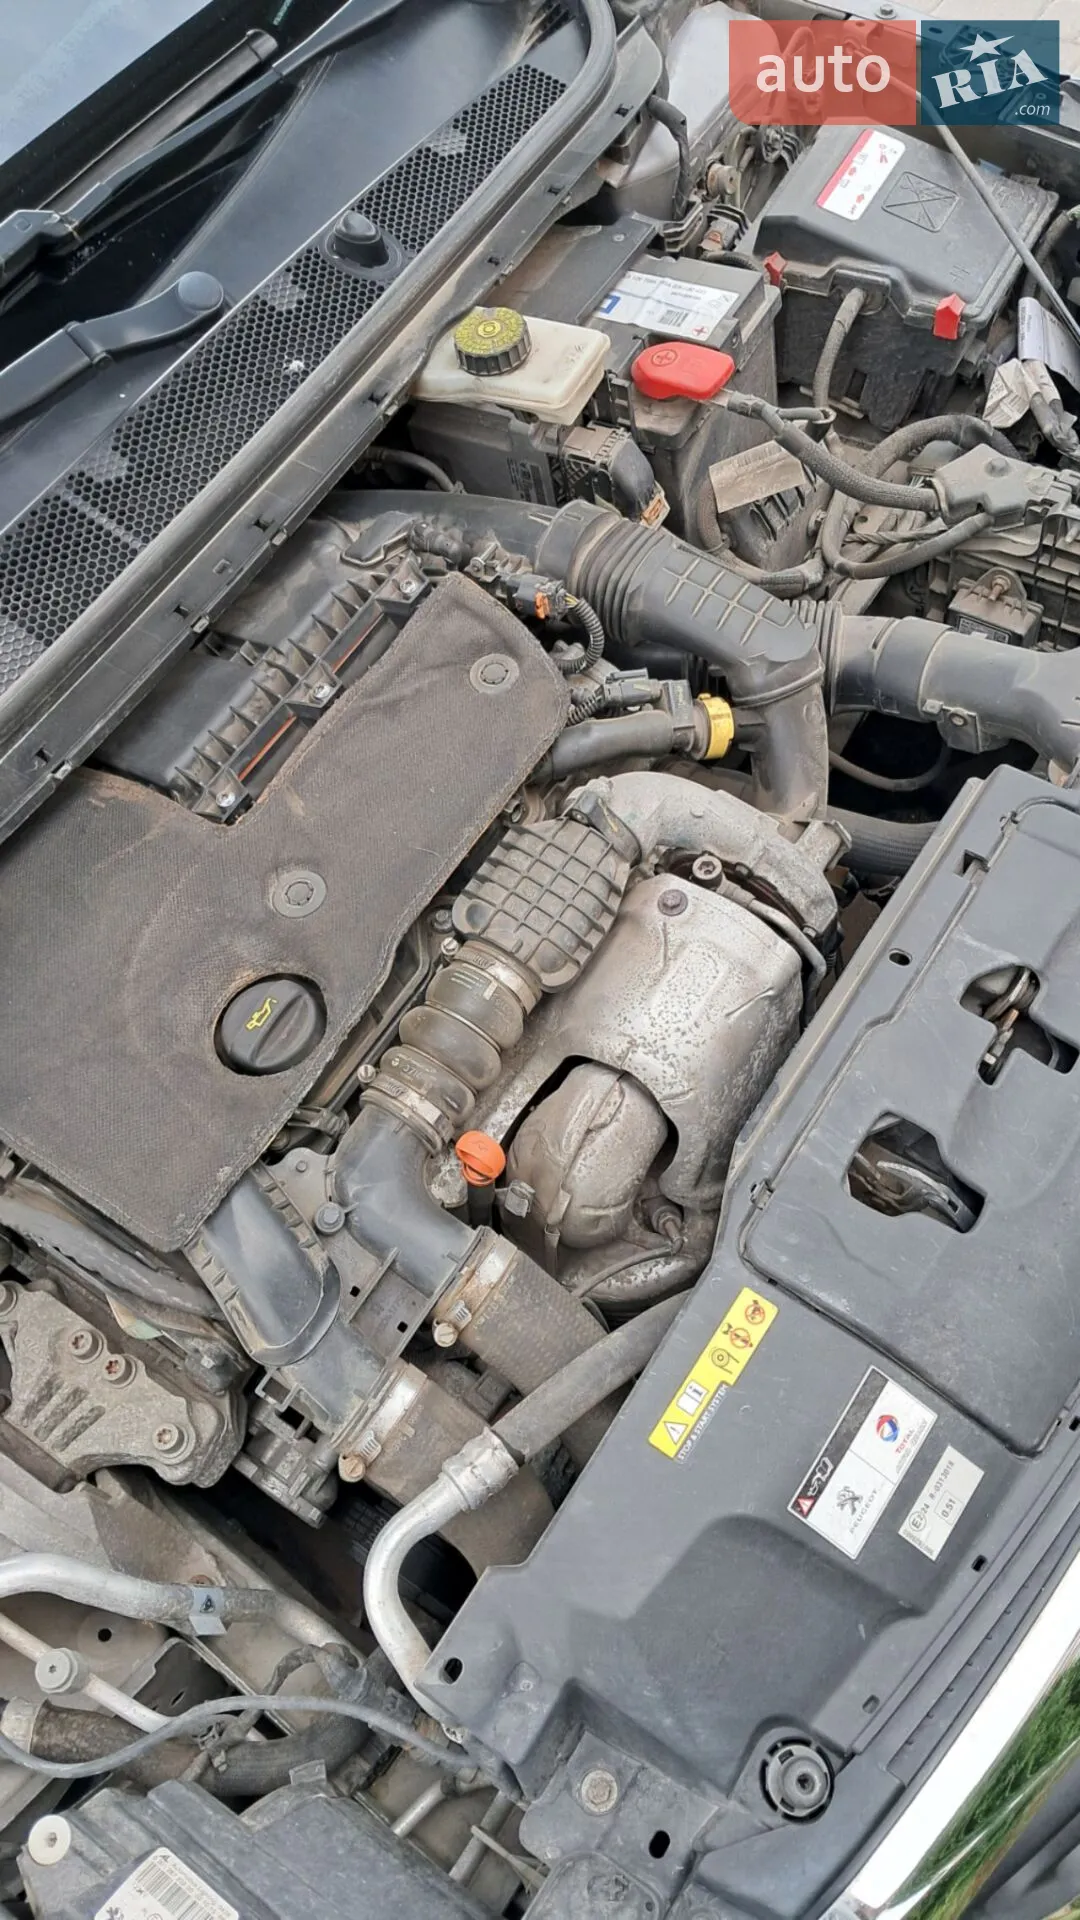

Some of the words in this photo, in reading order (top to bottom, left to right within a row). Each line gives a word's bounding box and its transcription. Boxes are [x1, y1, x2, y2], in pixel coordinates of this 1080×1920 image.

[677, 1438, 695, 1460] STOP
[692, 1411, 712, 1435] START
[706, 1383, 729, 1413] SYSTEM
[895, 1427, 914, 1454] TOTAL
[849, 1488, 879, 1534] PEUGEOT
[940, 1498, 957, 1519] 0.51
